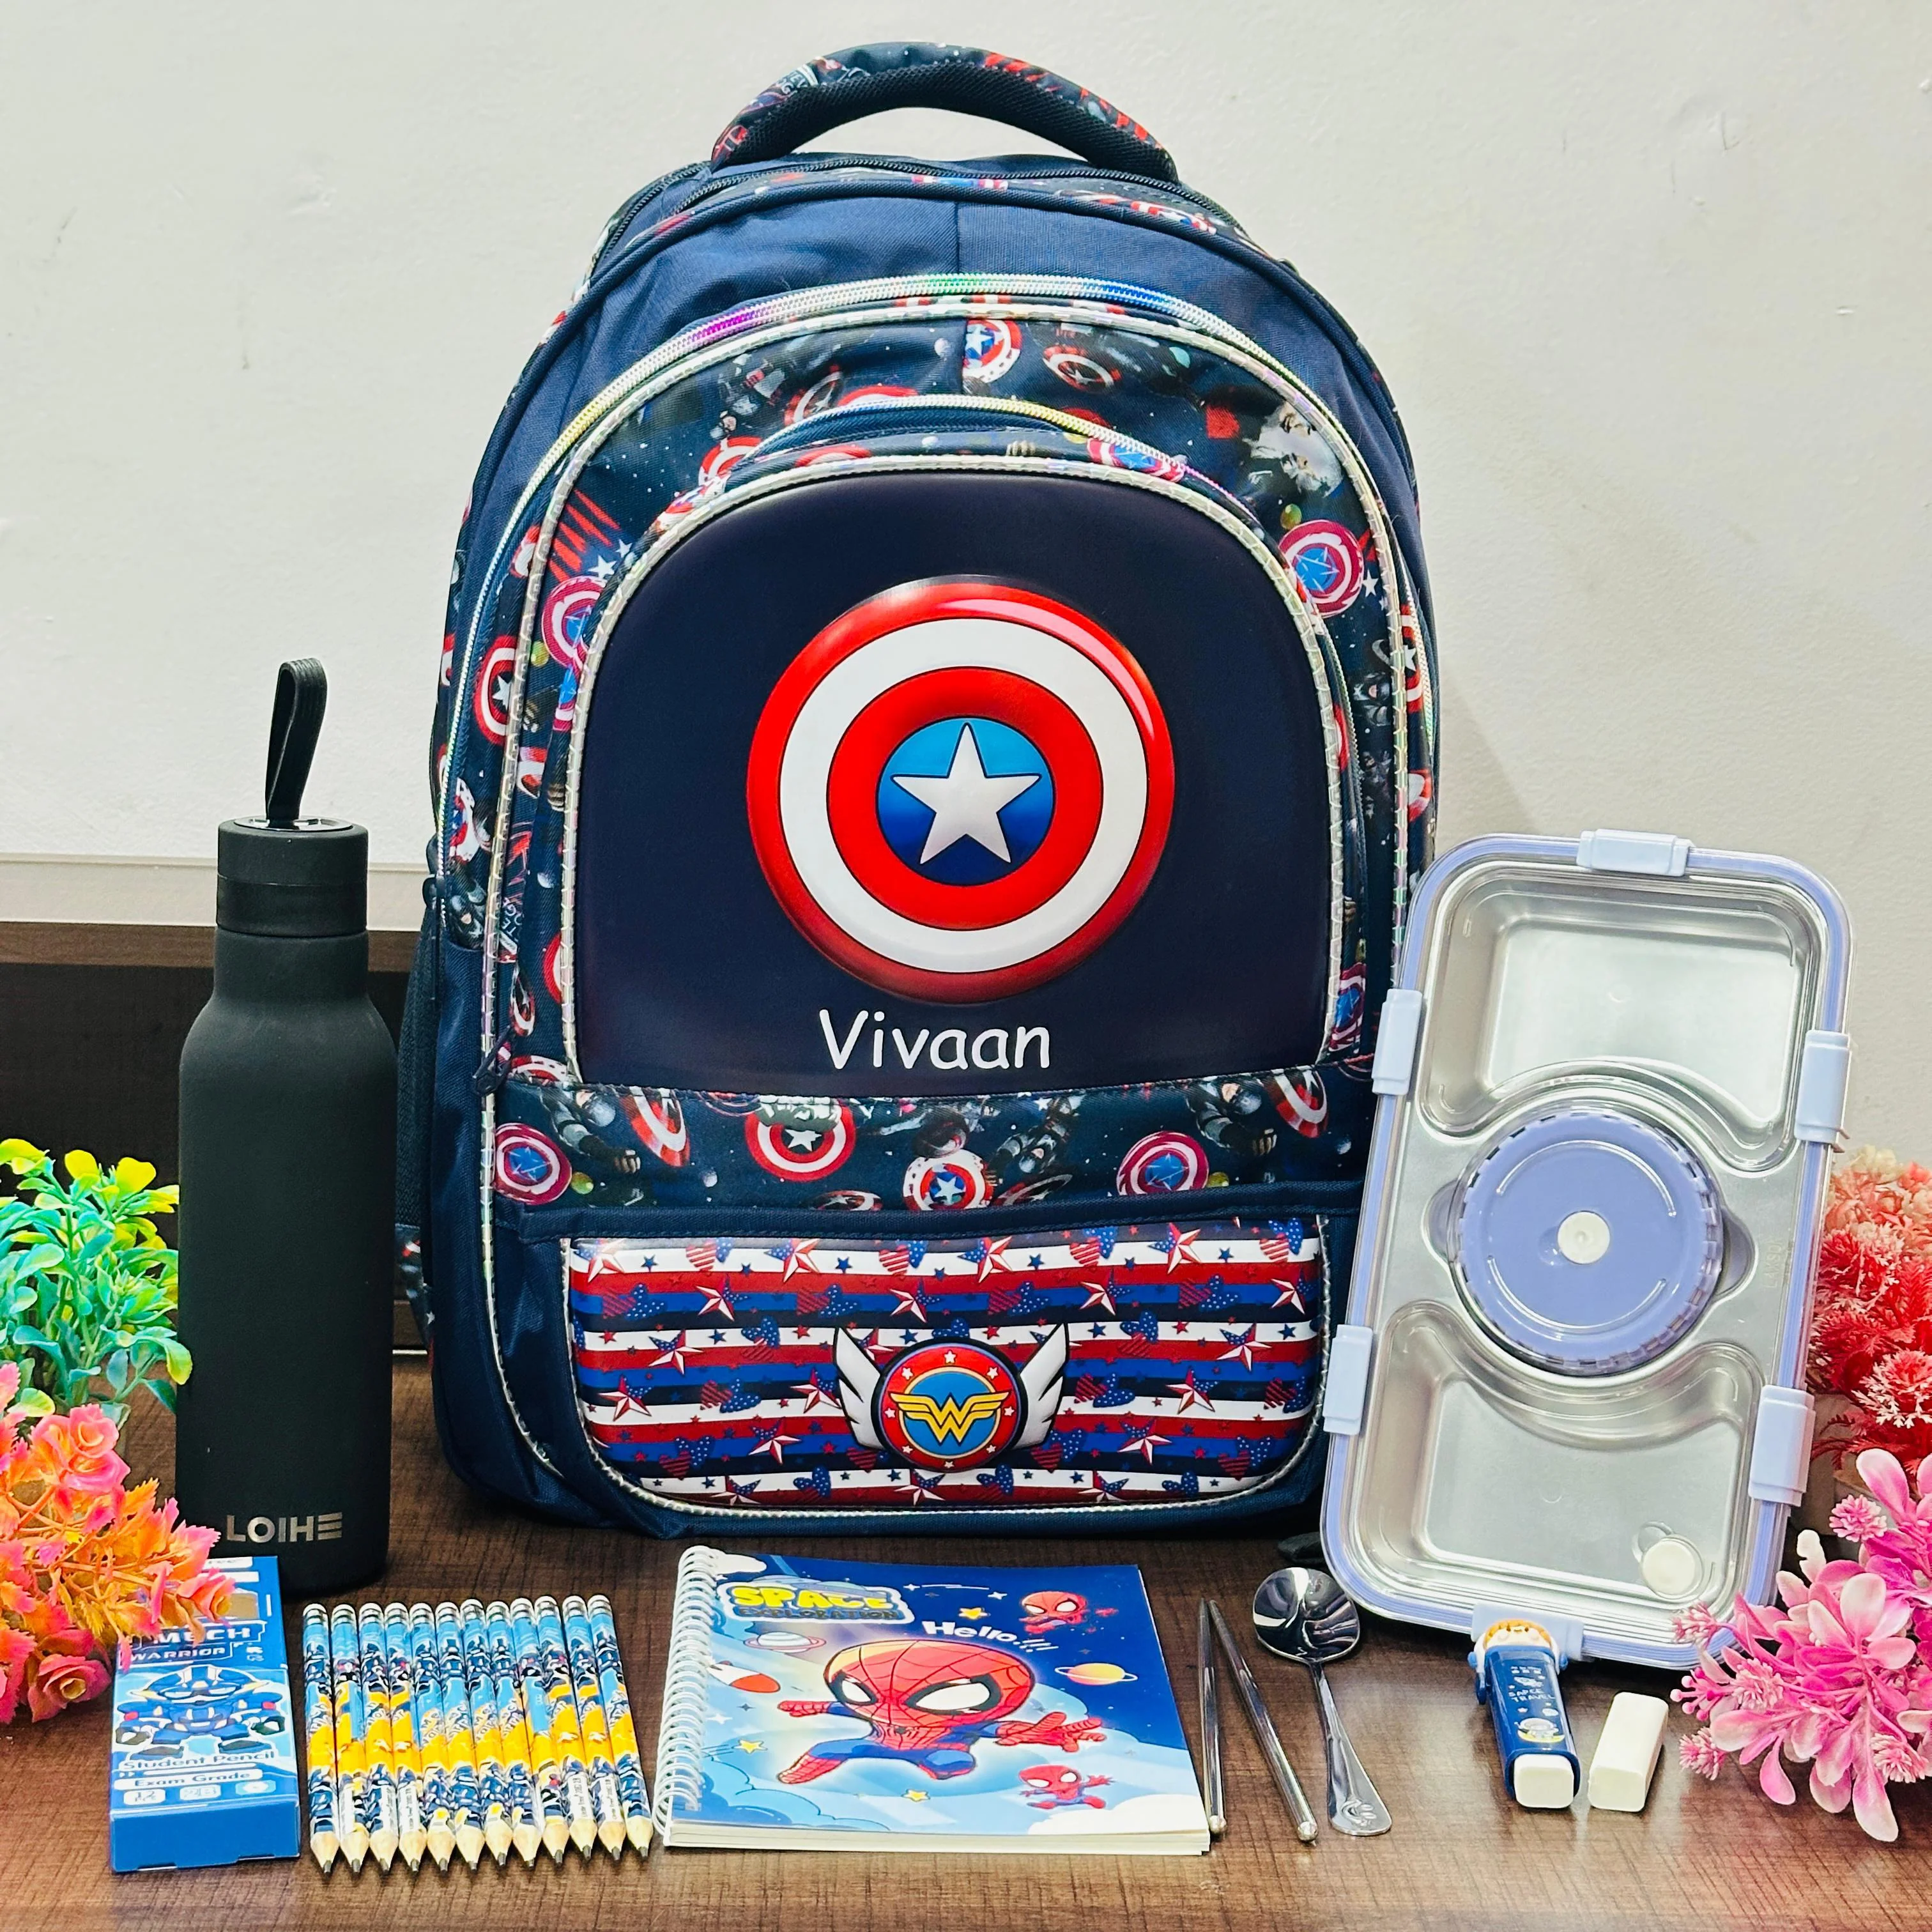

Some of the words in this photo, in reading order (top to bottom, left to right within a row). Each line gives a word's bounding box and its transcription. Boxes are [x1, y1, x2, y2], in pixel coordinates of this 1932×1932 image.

[819, 1009, 1050, 1070] Vivaan
[732, 1585, 894, 1609] SPACE
[739, 1607, 900, 1620] EXPLORATION
[131, 1647, 226, 1661] WARRIOR
[124, 1757, 204, 1770] Student
[213, 1751, 275, 1763] Pencil
[134, 1777, 185, 1787] Exam
[192, 1772, 250, 1782] Grade
